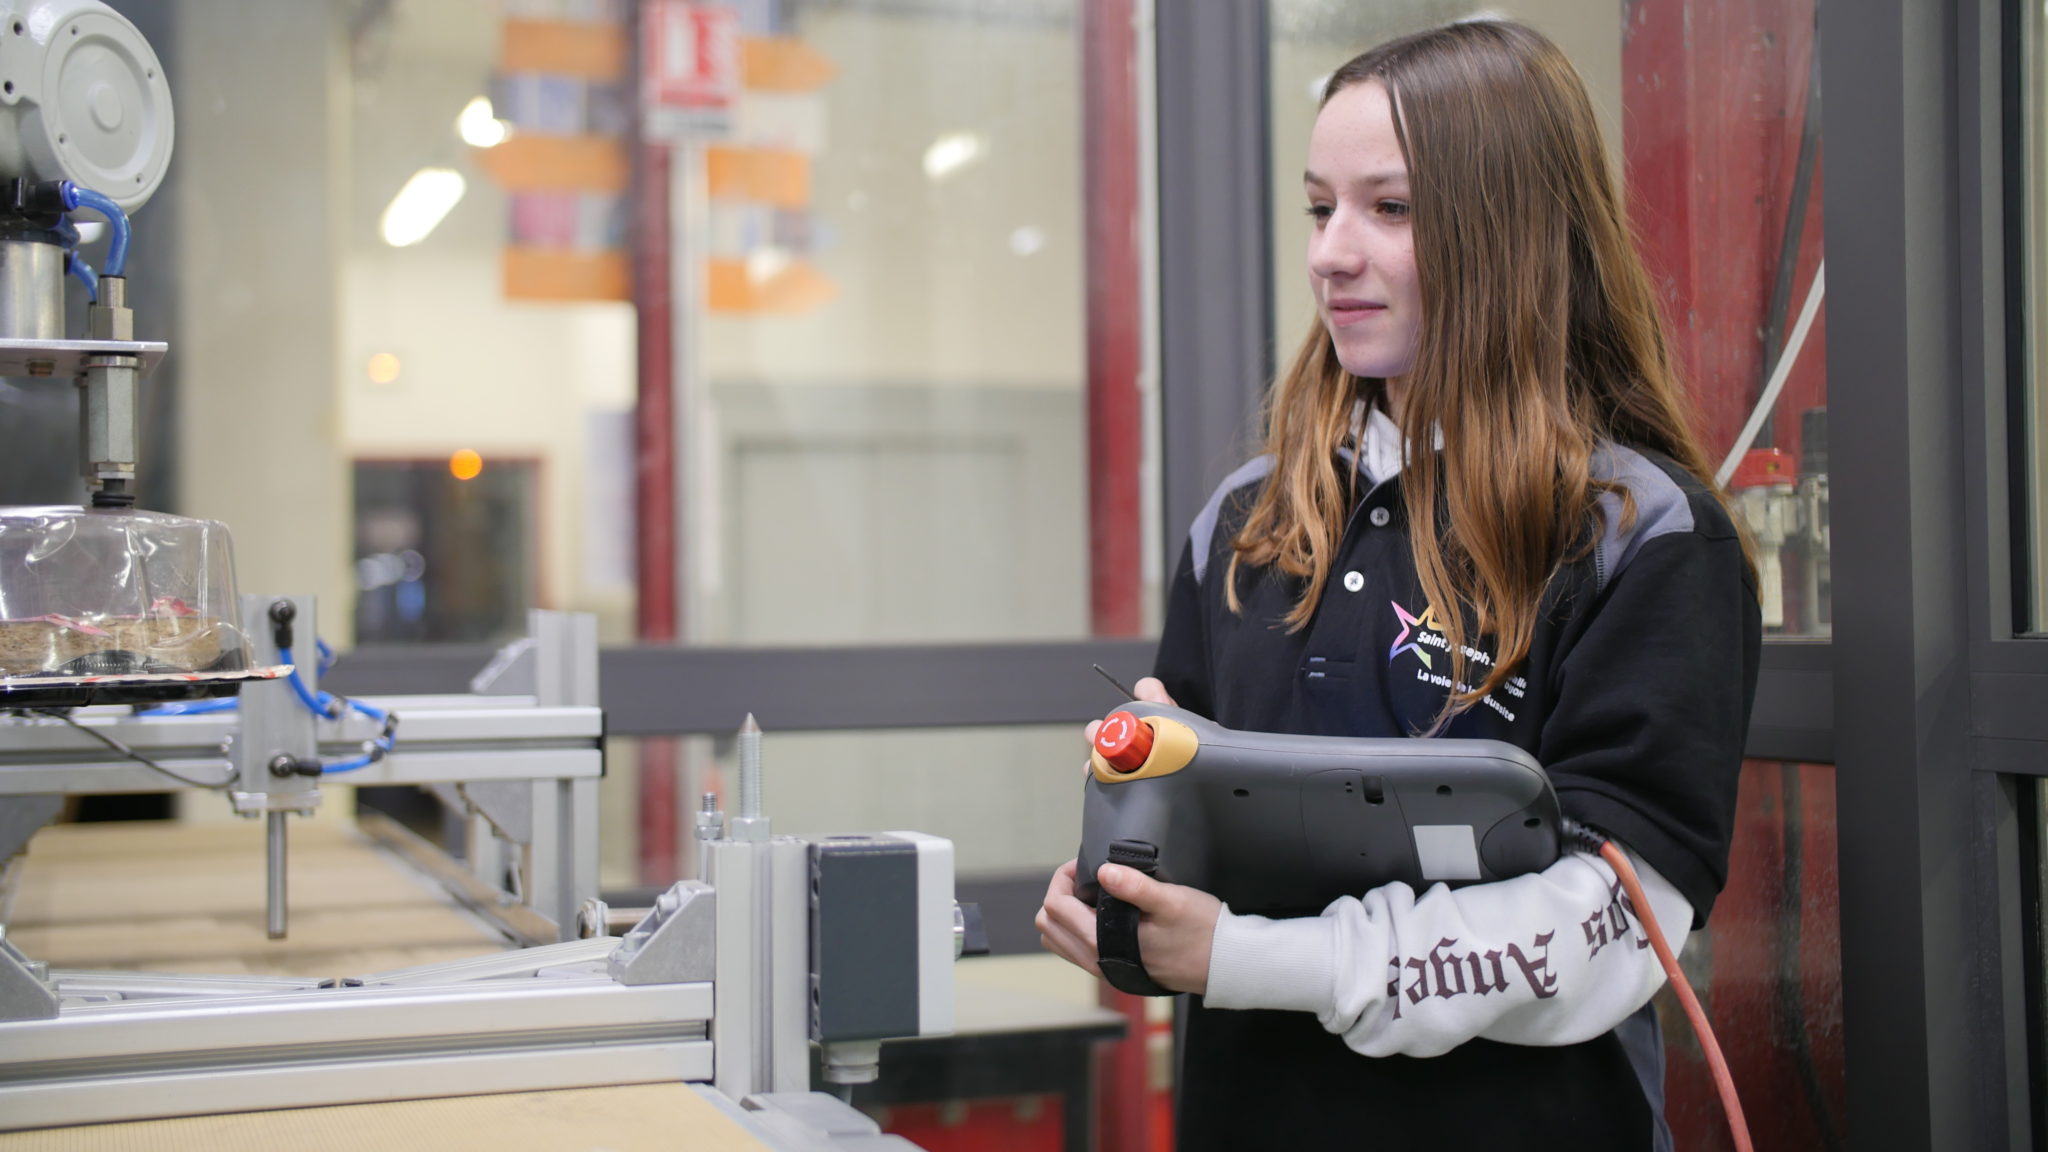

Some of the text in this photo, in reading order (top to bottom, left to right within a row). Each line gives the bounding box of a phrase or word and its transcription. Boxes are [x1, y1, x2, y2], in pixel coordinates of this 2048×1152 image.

[1417, 631, 1447, 649] Saint
[1445, 644, 1491, 666] Jseph
[1417, 668, 1430, 682] La
[1430, 674, 1452, 688] voie
[1482, 694, 1515, 721] éussite
